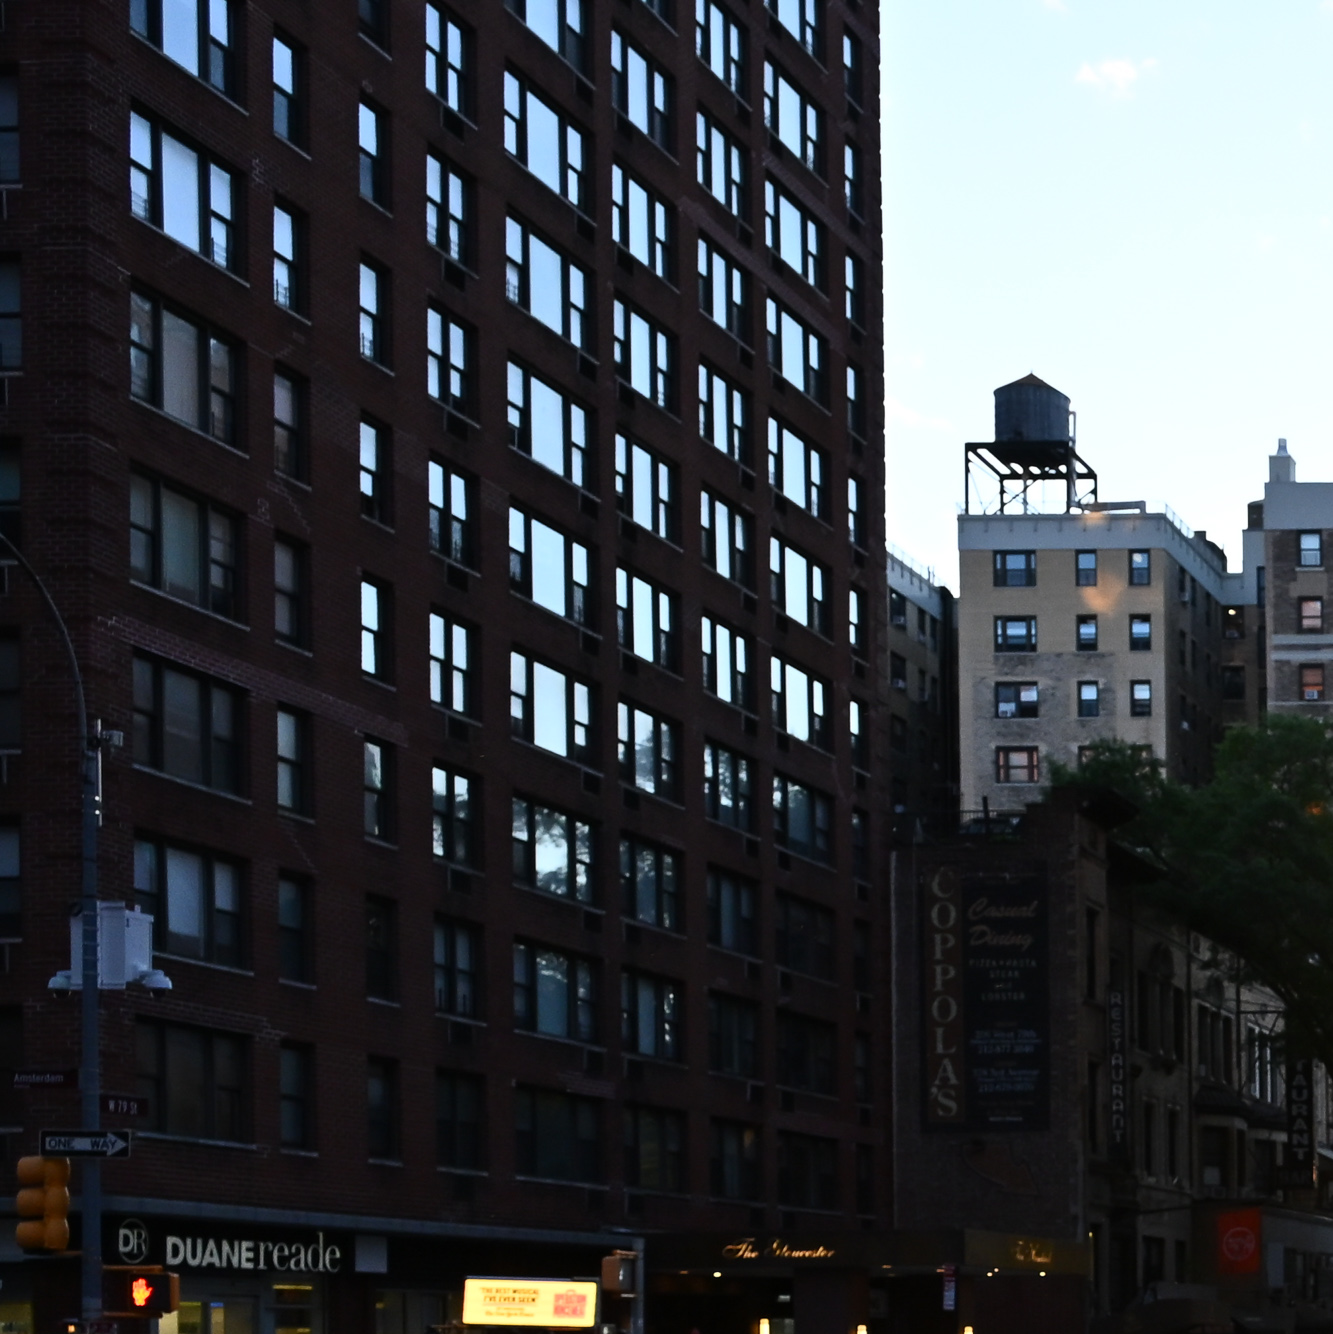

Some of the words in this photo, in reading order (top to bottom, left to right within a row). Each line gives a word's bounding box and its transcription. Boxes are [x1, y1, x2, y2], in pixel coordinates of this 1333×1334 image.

[968, 897, 1039, 920] Casual
[969, 925, 1033, 951] Dining
[14, 1072, 64, 1084] Amsterdam
[108, 1099, 116, 1112] W
[118, 1100, 128, 1114] 79
[130, 1102, 138, 1115] St
[48, 1138, 75, 1149] ONE
[90, 1138, 117, 1150] WAY
[118, 1228, 147, 1254] DR
[722, 1237, 760, 1259] The
